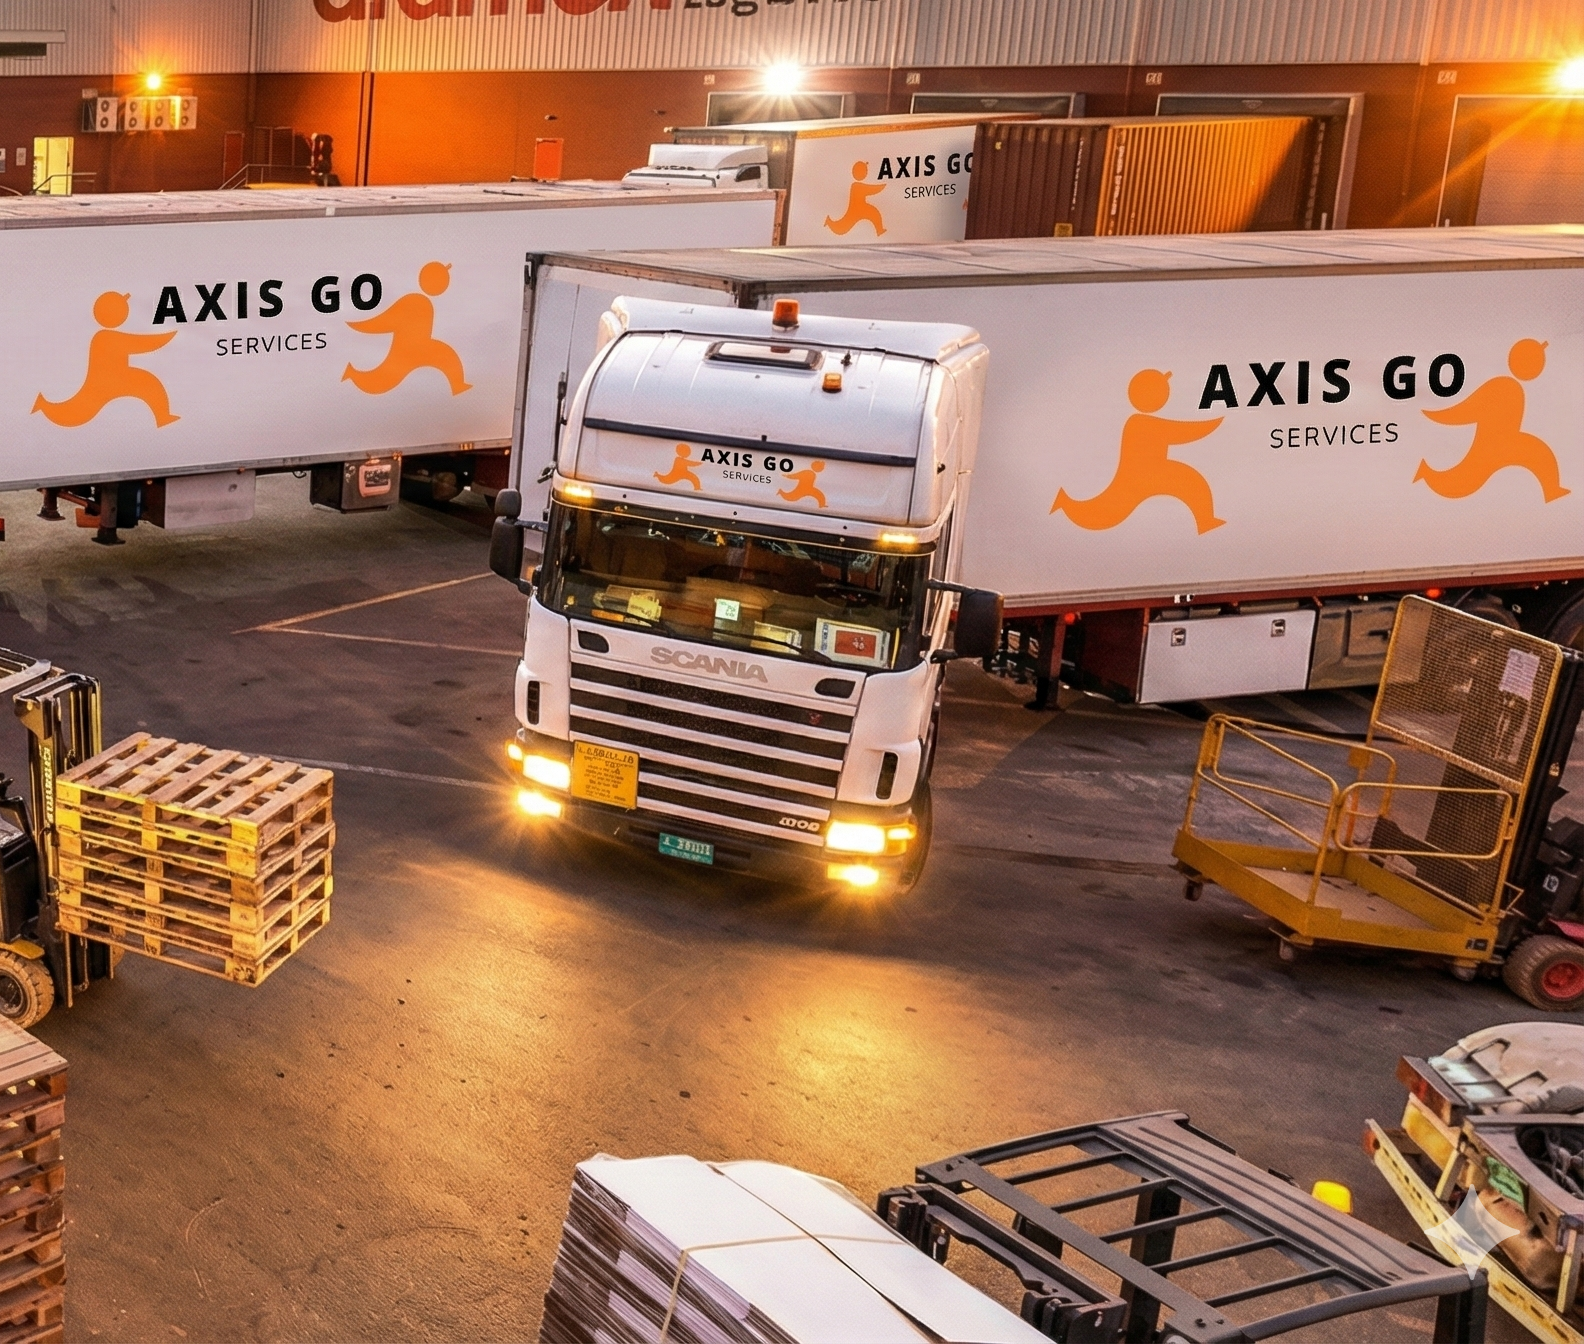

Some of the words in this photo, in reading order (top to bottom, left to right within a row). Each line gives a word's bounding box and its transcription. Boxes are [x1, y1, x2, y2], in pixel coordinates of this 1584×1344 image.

[877, 155, 936, 180] AXIS
[904, 183, 957, 199] SERVICES
[152, 279, 284, 325] AXIS
[311, 273, 383, 314] GO
[216, 332, 328, 357] SERVICES
[1198, 358, 1351, 410] AXIS
[1382, 353, 1465, 400] GO
[1270, 422, 1399, 449] SERVICES
[701, 448, 753, 469] AXIS
[763, 455, 794, 473] GO
[722, 469, 772, 484] SERVICES
[650, 646, 769, 683] SCANIA
